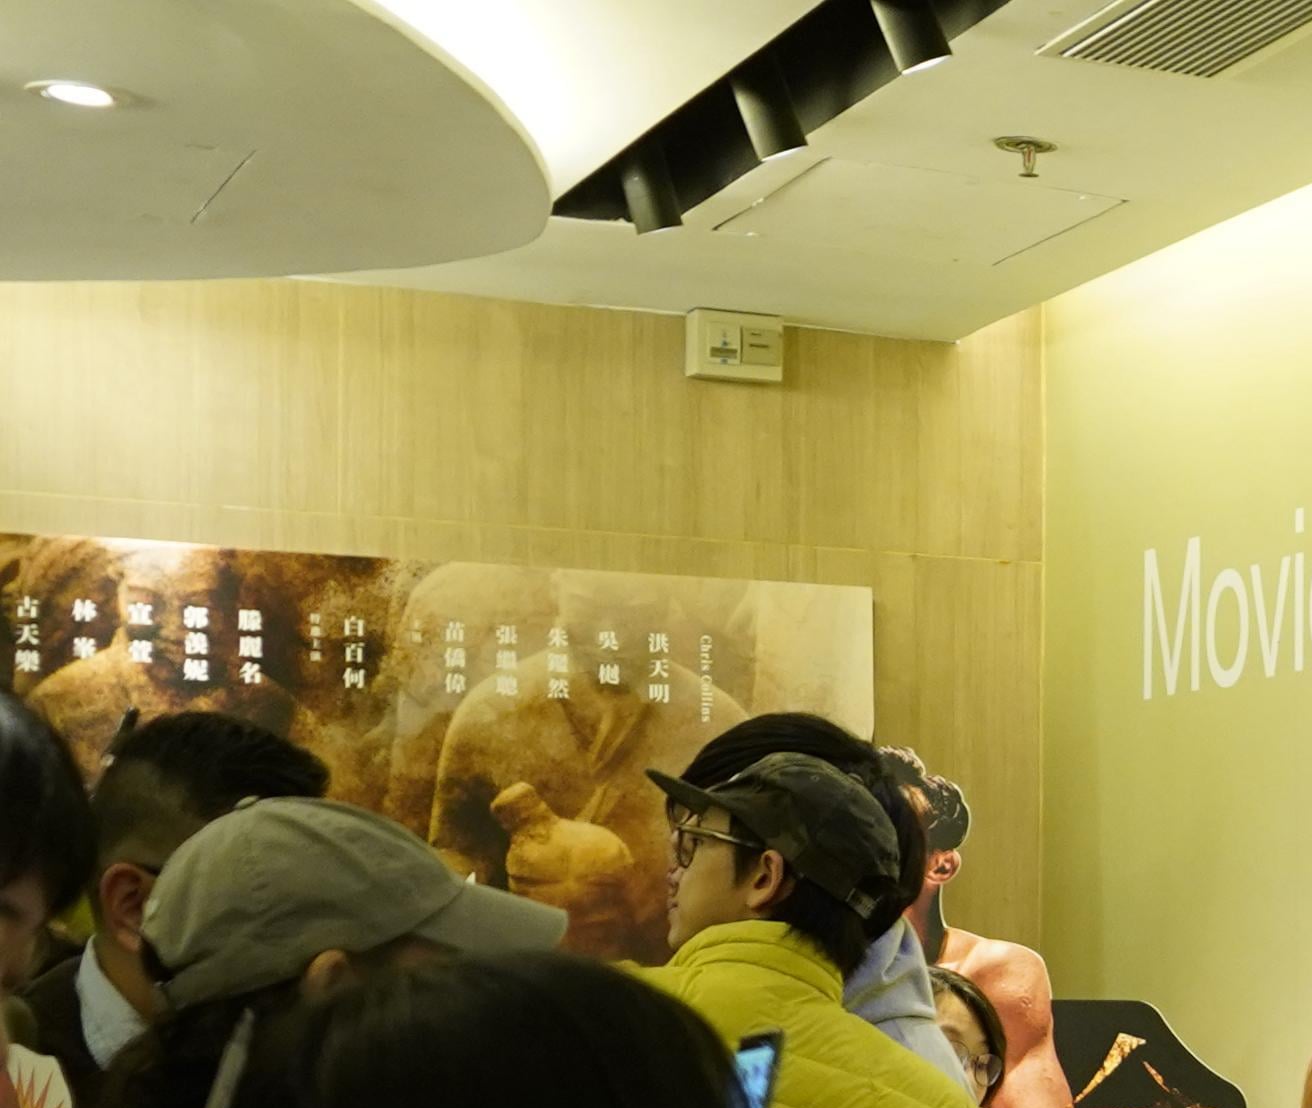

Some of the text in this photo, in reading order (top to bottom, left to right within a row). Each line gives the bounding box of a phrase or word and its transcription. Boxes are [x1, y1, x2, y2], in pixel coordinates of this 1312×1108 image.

[15, 596, 41, 672] 古天樂
[343, 615, 365, 689] 白百何
[648, 633, 670, 704] 洪天明
